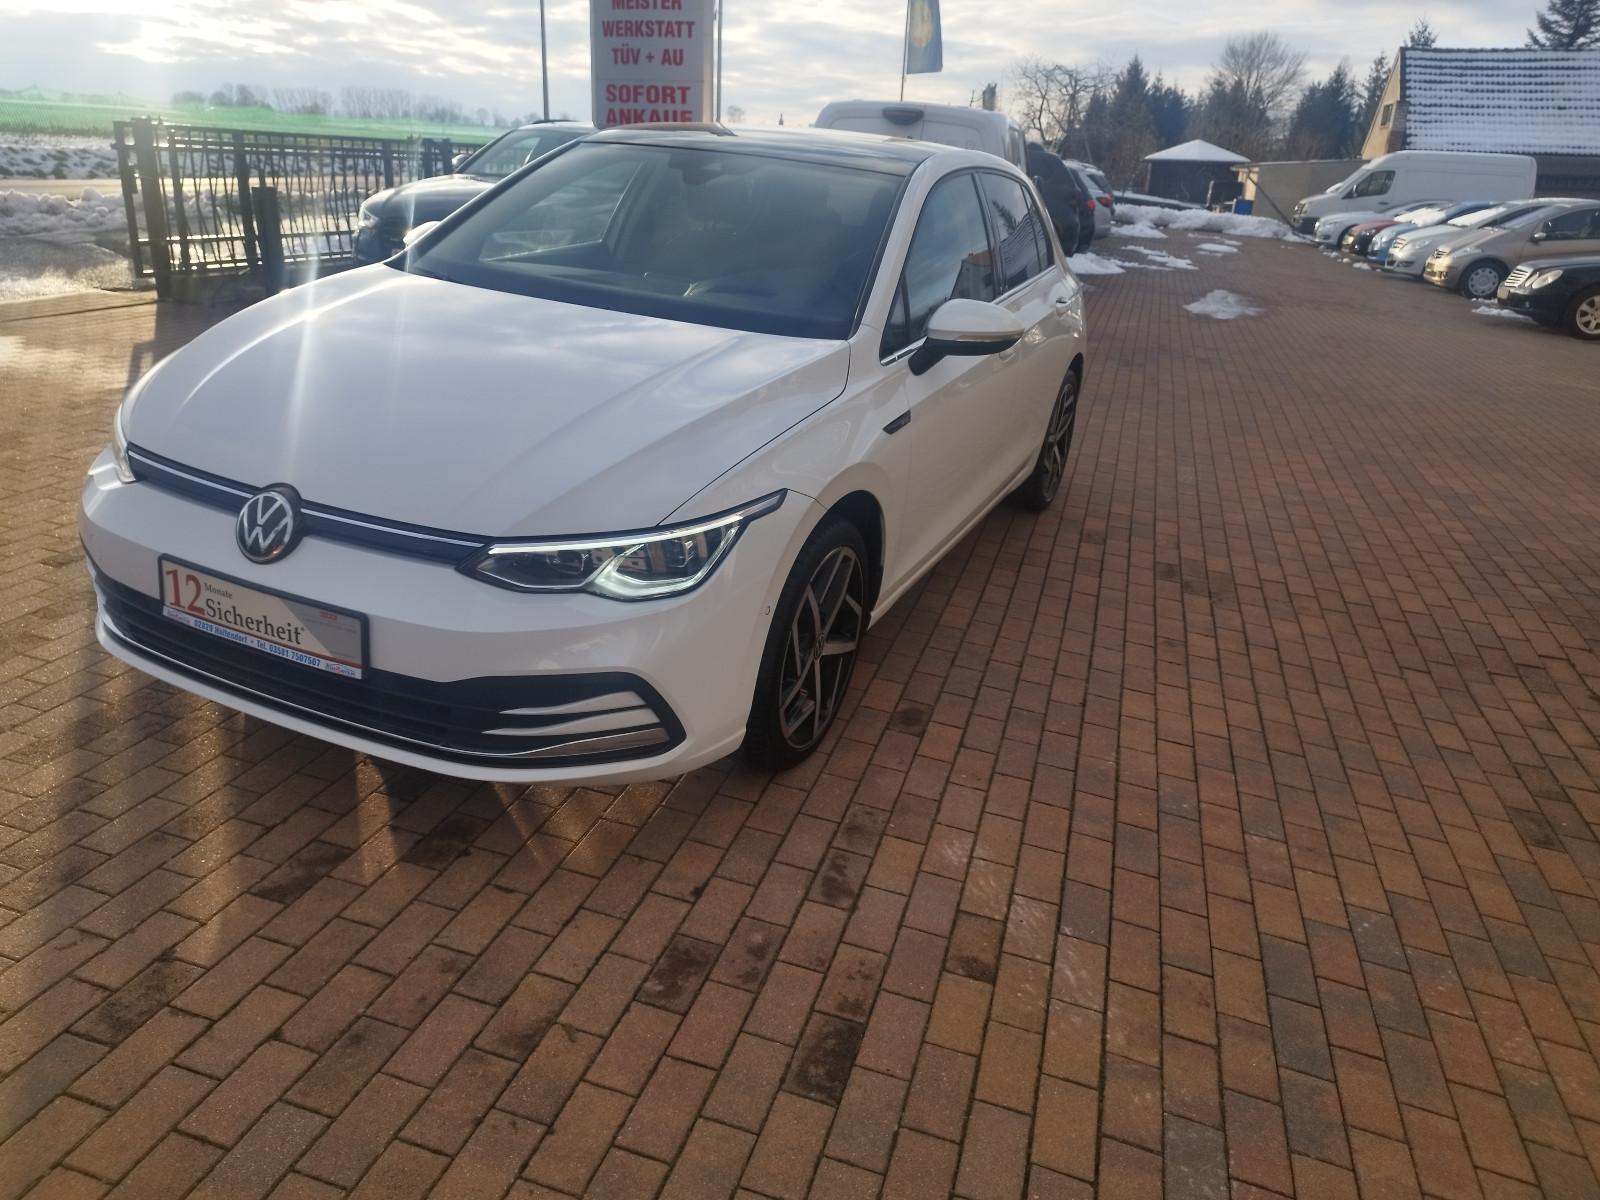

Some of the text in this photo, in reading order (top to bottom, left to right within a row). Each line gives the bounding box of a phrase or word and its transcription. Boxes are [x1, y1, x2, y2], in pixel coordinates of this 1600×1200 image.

[612, 0, 682, 10] MEISTER
[602, 20, 695, 38] WERKSTATT
[611, 43, 640, 65] TÜV
[661, 48, 684, 66] AU
[606, 84, 691, 104] SOFORT
[606, 108, 692, 126] ANKAUF
[165, 569, 205, 615] 12
[204, 582, 232, 599] Monate
